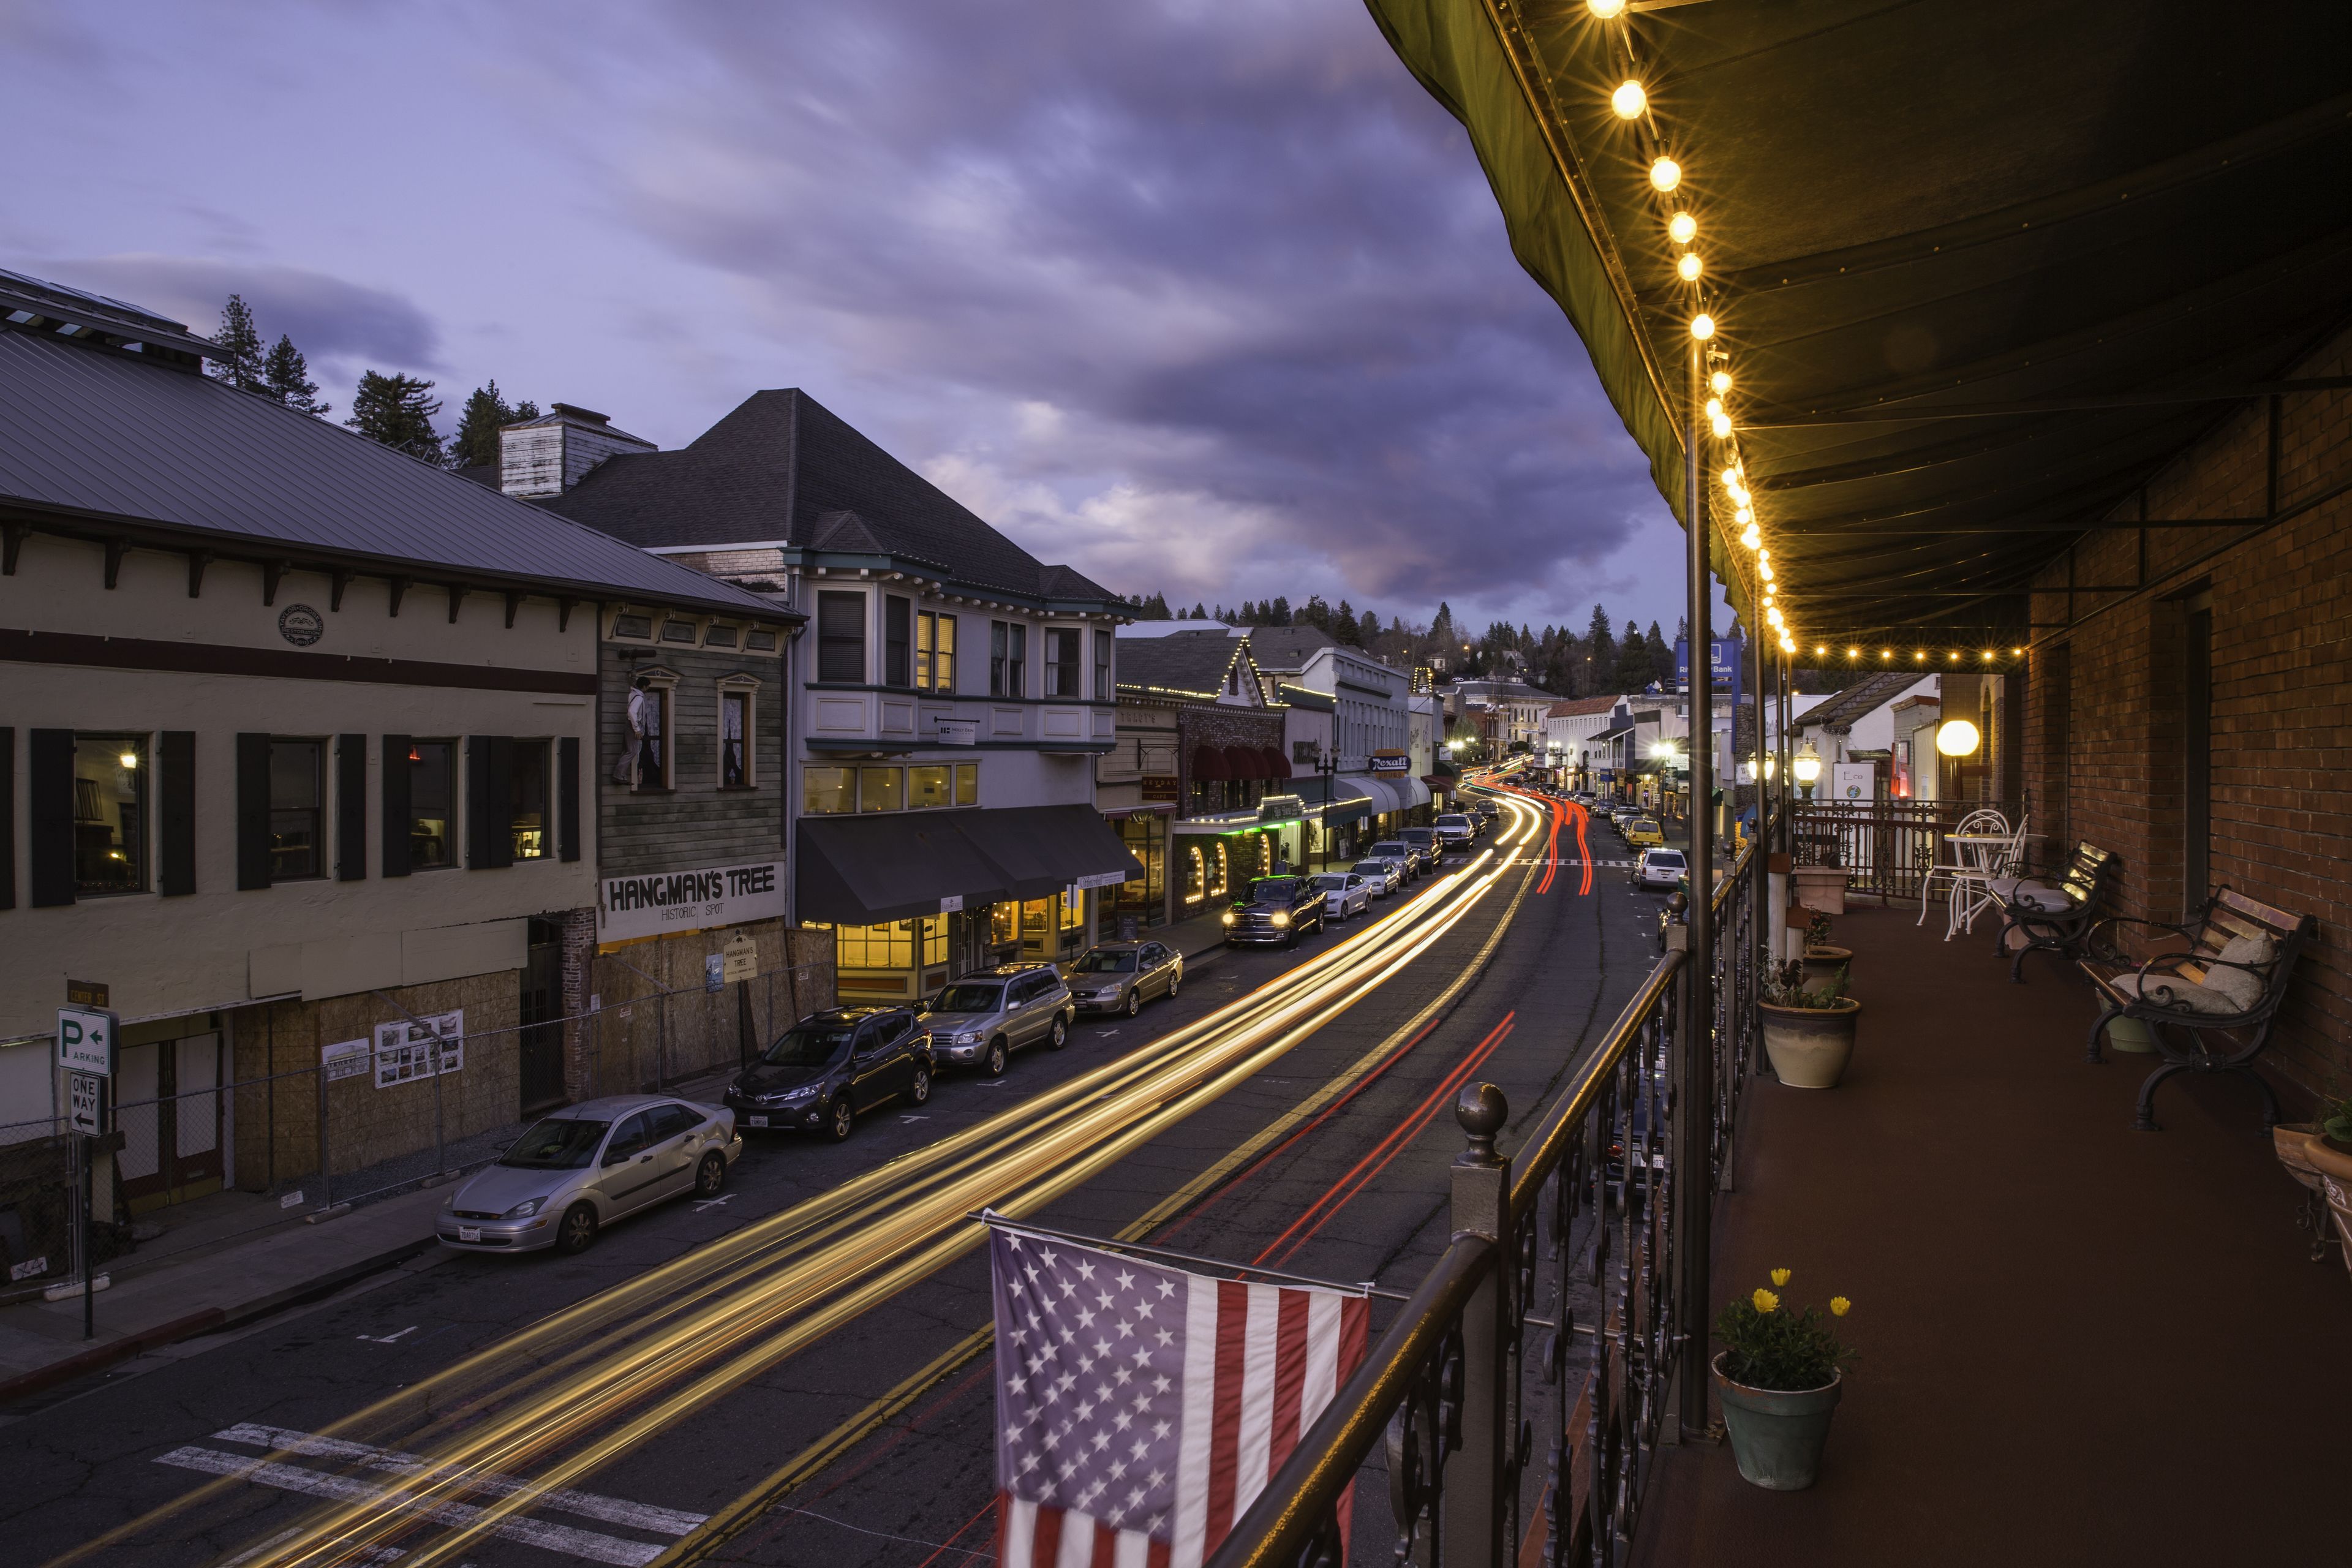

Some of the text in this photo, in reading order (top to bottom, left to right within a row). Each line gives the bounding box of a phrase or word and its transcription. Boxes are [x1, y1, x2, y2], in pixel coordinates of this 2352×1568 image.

[280, 606, 298, 627] TAYLOR
[1373, 756, 1408, 771] Rexall
[609, 865, 775, 911] HANGMAN'S TREE
[661, 902, 725, 921] HISTORIC SPOT
[726, 946, 754, 967] HANGMAN'S TREE
[70, 989, 105, 1005] CENTER ST
[73, 1078, 95, 1096] ONE
[73, 1094, 96, 1112] WAY
